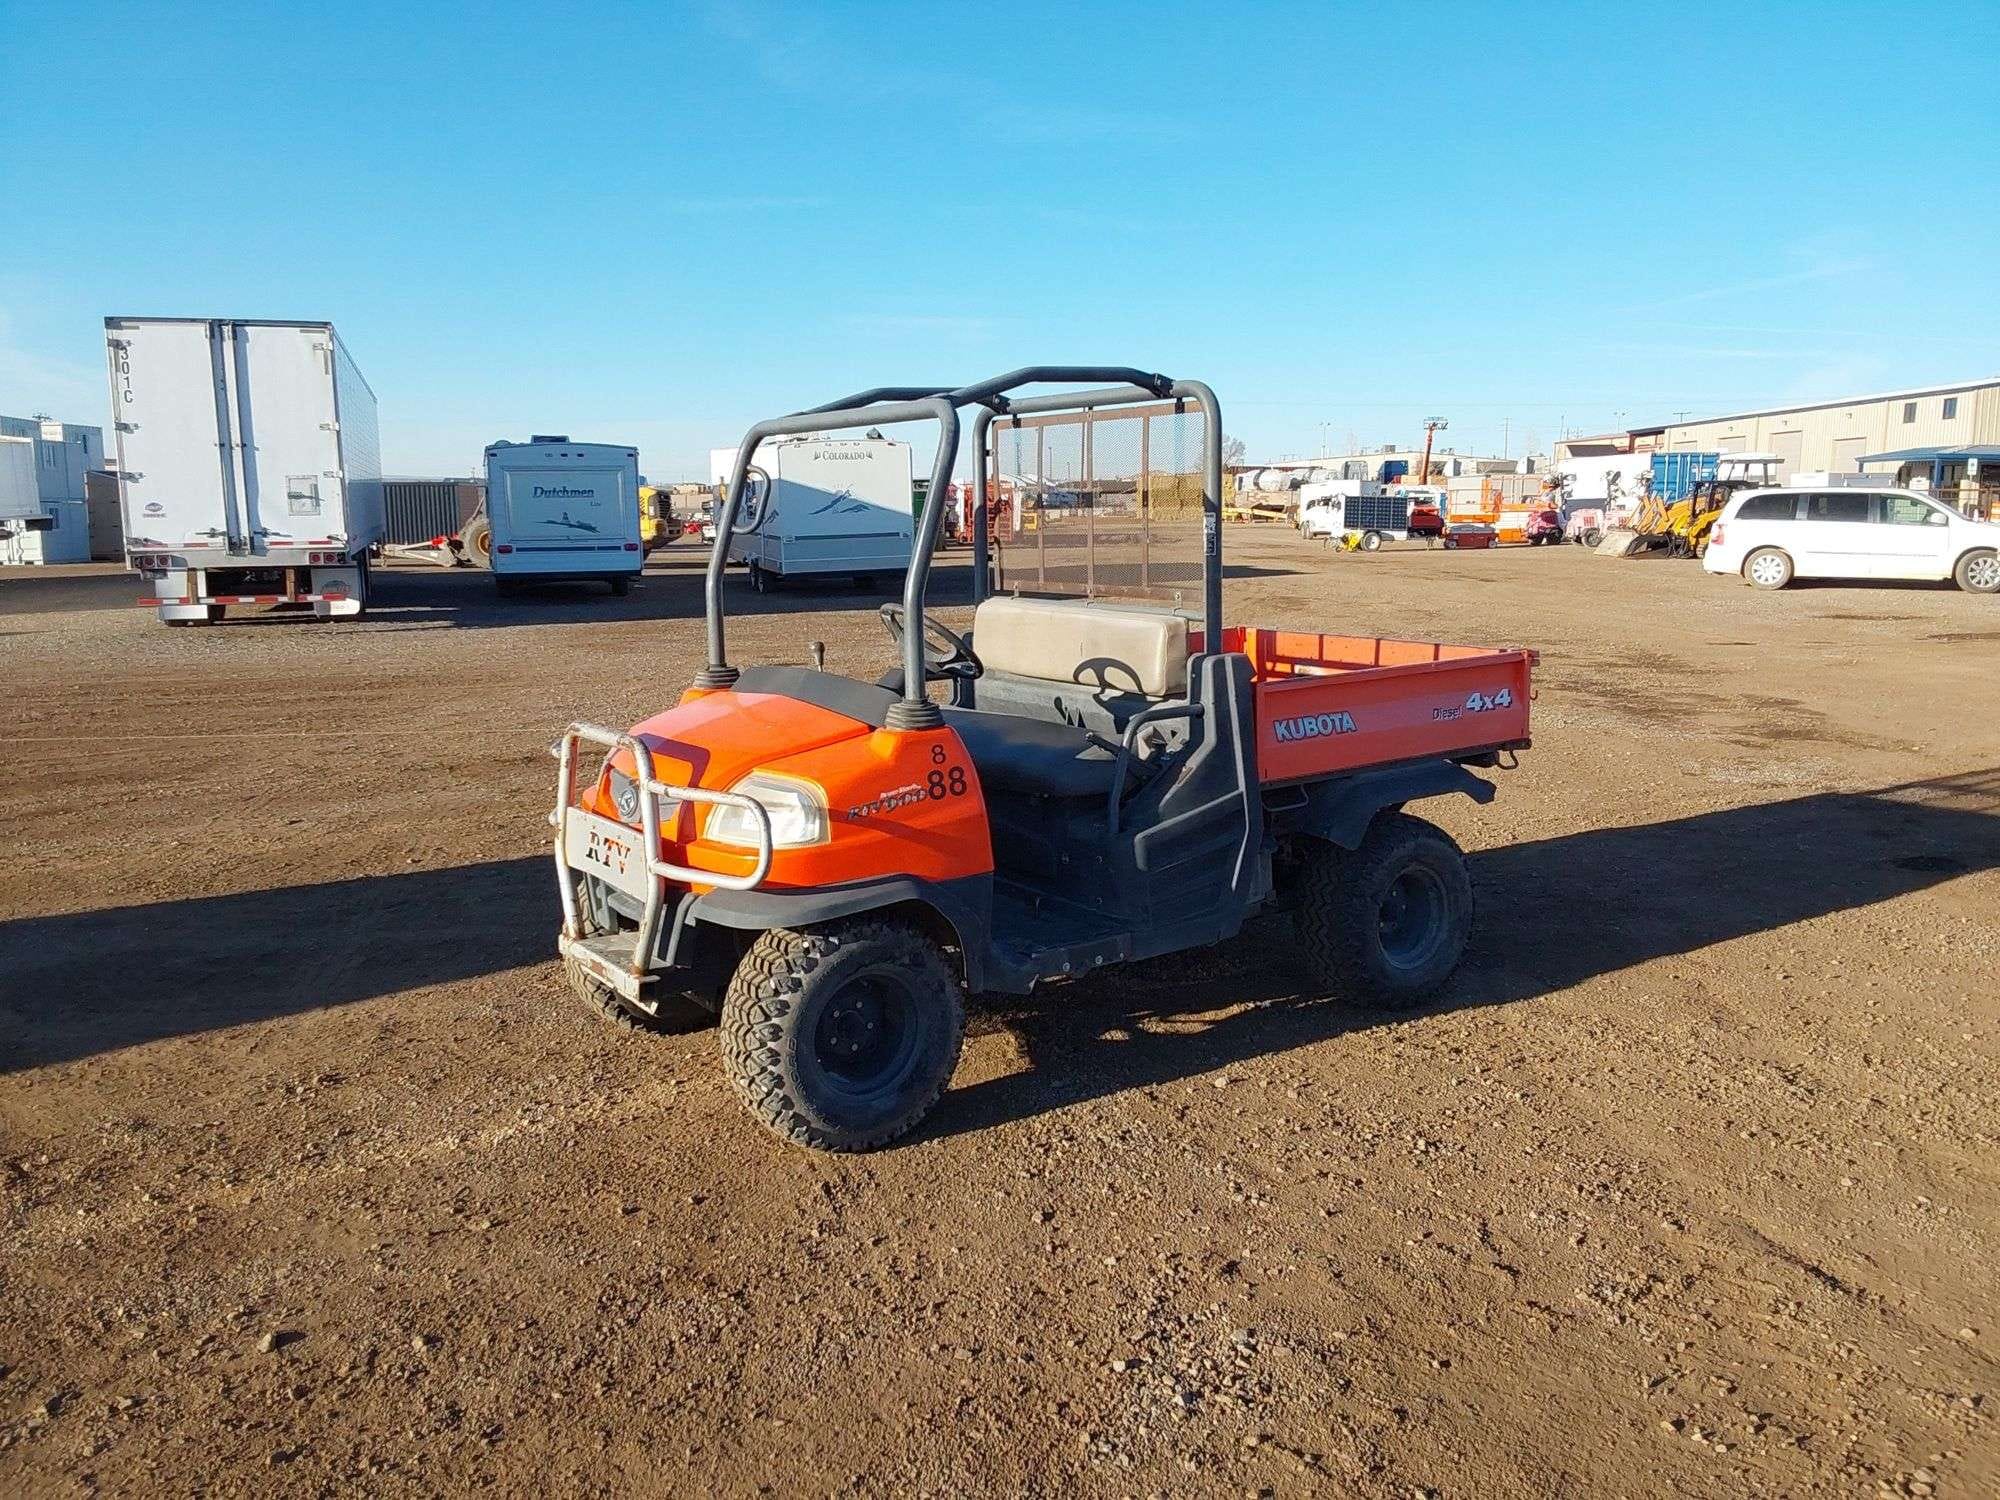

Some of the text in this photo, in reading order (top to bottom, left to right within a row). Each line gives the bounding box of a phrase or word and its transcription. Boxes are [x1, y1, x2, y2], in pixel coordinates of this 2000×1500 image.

[822, 450, 865, 460] COLORADO
[532, 486, 594, 498] Dutchmen
[1432, 688, 1512, 721] Diesel 4x4
[1273, 710, 1357, 743] KUBOTA
[931, 744, 946, 765] 8
[927, 766, 967, 800] 88
[586, 831, 631, 875] RTV
